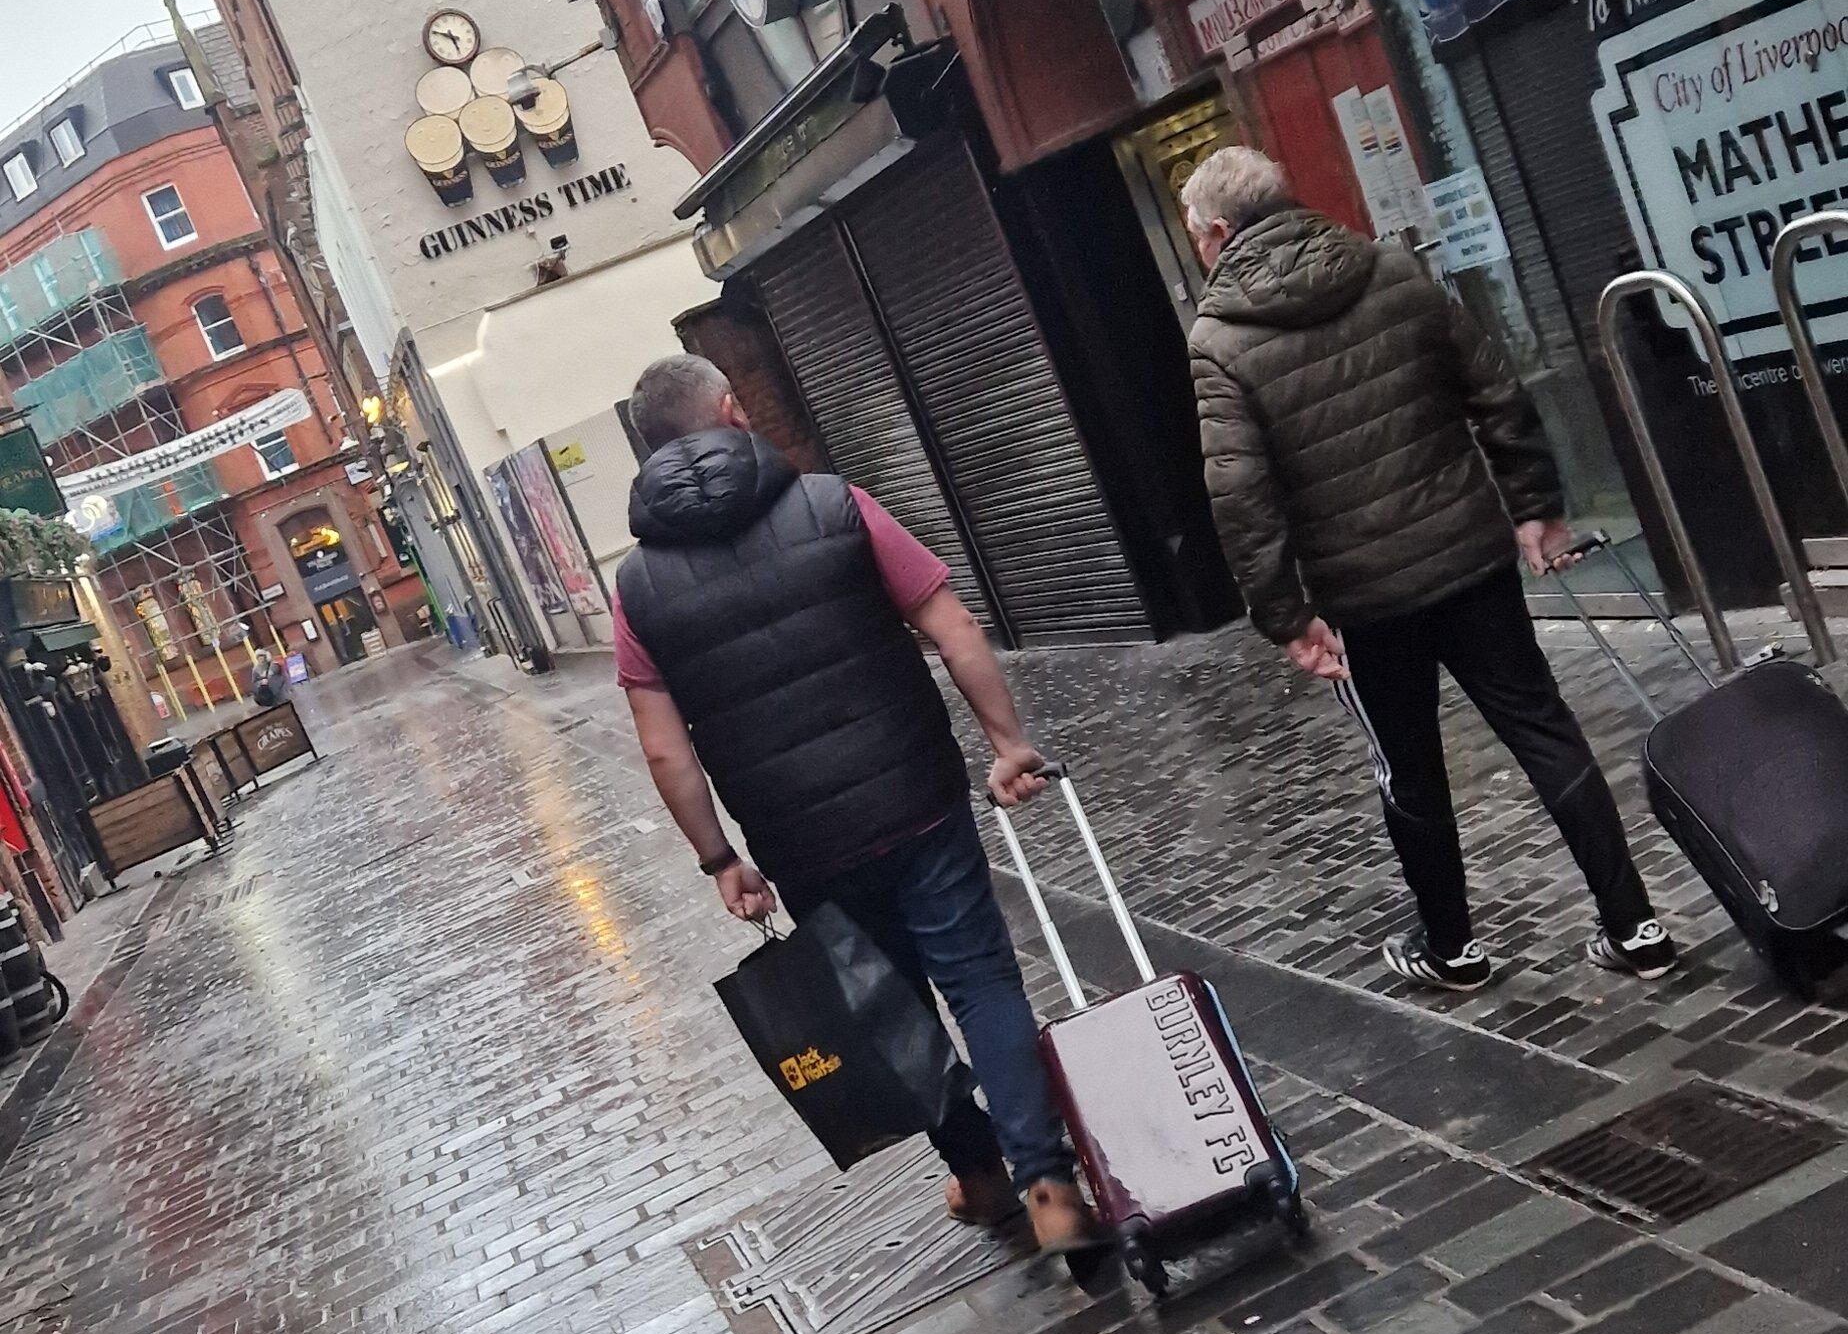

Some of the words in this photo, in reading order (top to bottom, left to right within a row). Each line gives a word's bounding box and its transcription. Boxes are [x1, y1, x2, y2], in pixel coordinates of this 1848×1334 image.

[1654, 70, 1703, 114] City
[1710, 46, 1734, 103] of
[419, 191, 554, 260] GUINNESS
[557, 162, 633, 208] TIME
[1686, 375, 1719, 396] The
[256, 726, 294, 752] GRAPES
[1145, 982, 1235, 1122] BURNLEY
[1205, 1125, 1256, 1175] FC
